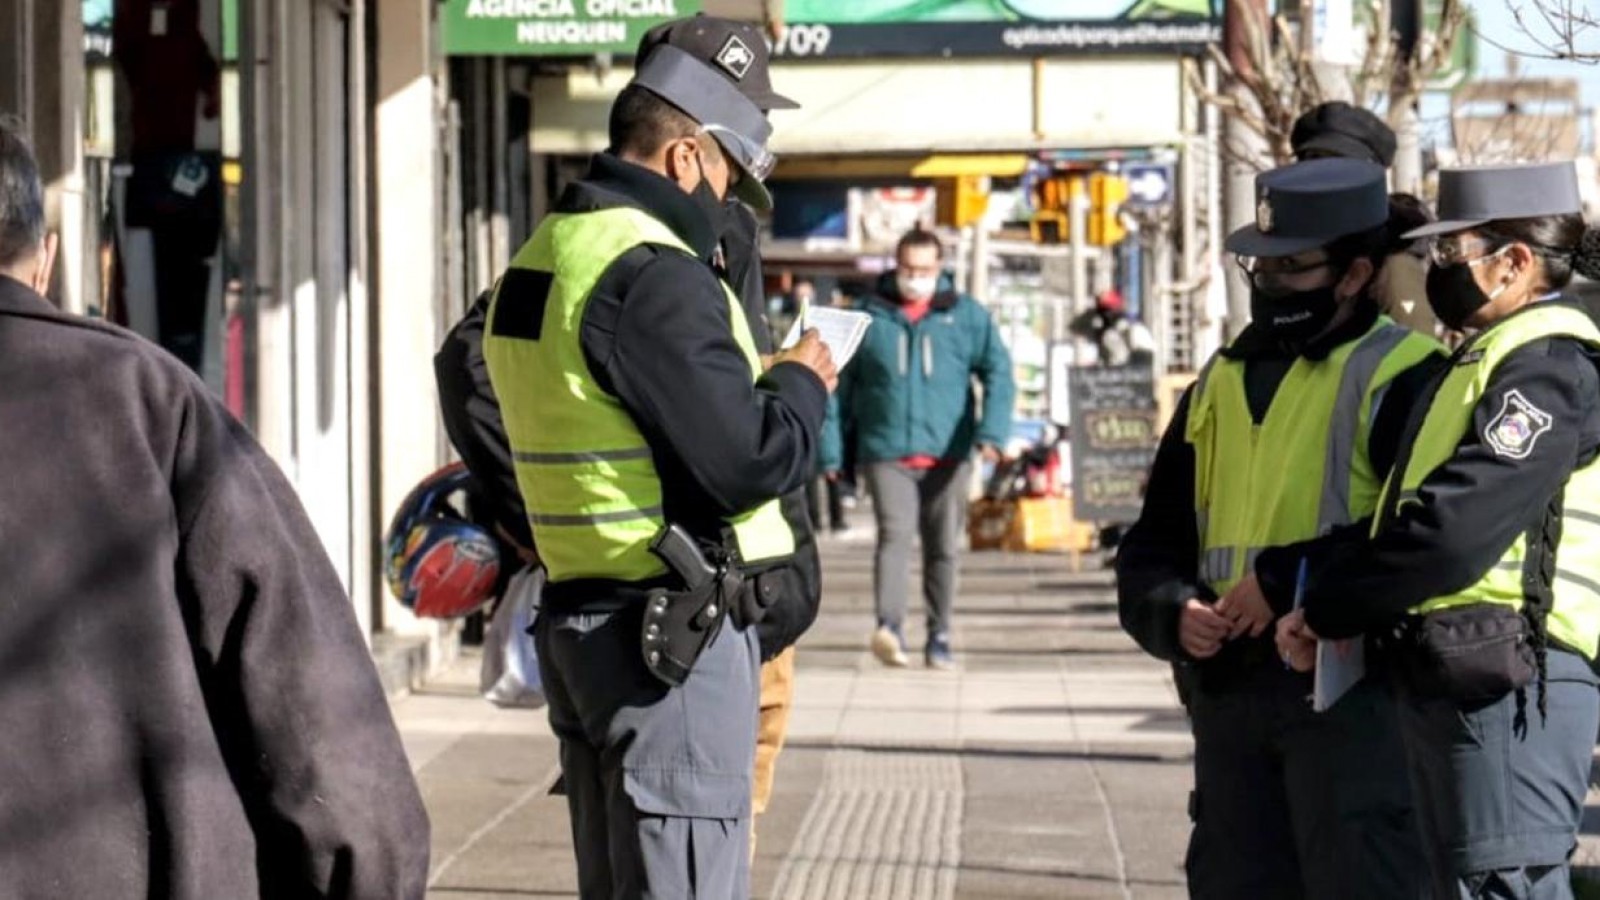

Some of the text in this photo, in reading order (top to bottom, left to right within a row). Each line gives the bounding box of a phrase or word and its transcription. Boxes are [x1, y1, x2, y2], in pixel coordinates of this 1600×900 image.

[466, 0, 677, 17] AGENCIA OFICIAL
[516, 20, 627, 43] NEUQUEN
[764, 24, 830, 55] 709
